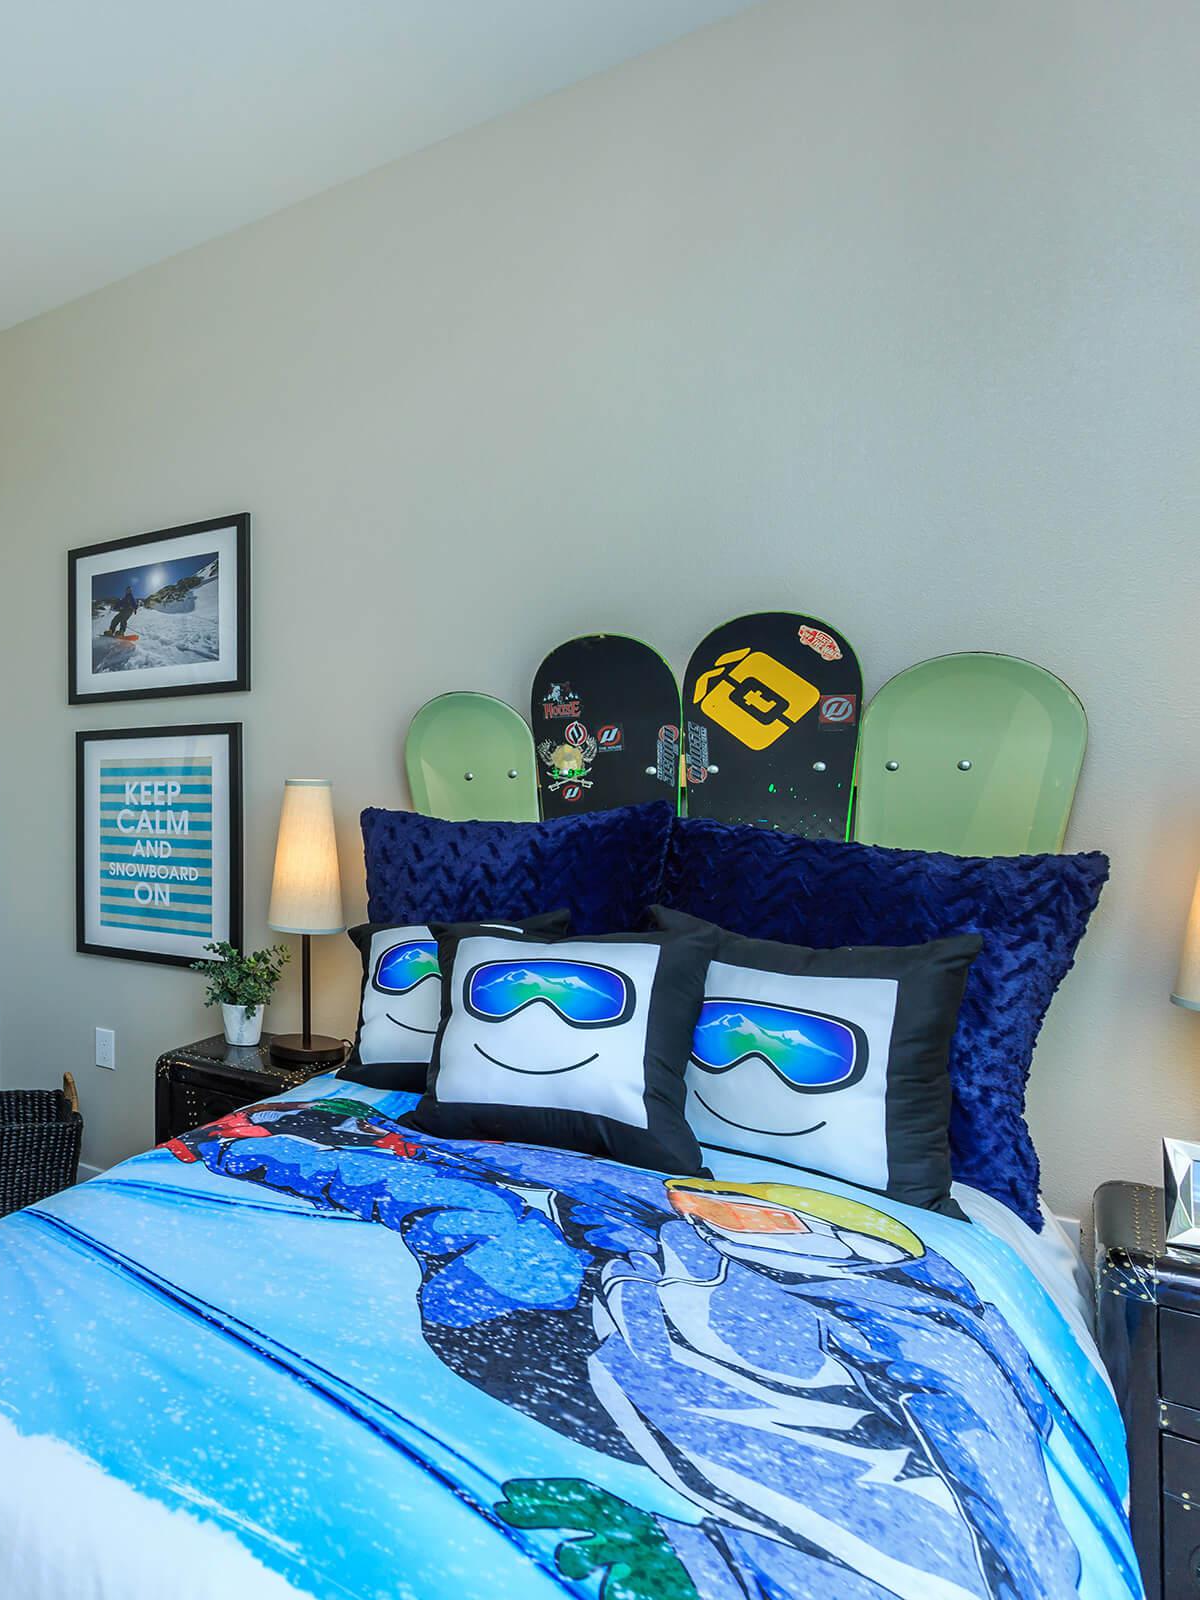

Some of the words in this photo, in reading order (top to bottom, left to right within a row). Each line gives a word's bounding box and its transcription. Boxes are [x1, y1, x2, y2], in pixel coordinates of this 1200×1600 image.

[125, 781, 181, 806] KEEP
[116, 809, 189, 835] CALM
[132, 840, 172, 858] AND
[109, 862, 198, 881] SNOWBOARD
[134, 883, 170, 906] ON
